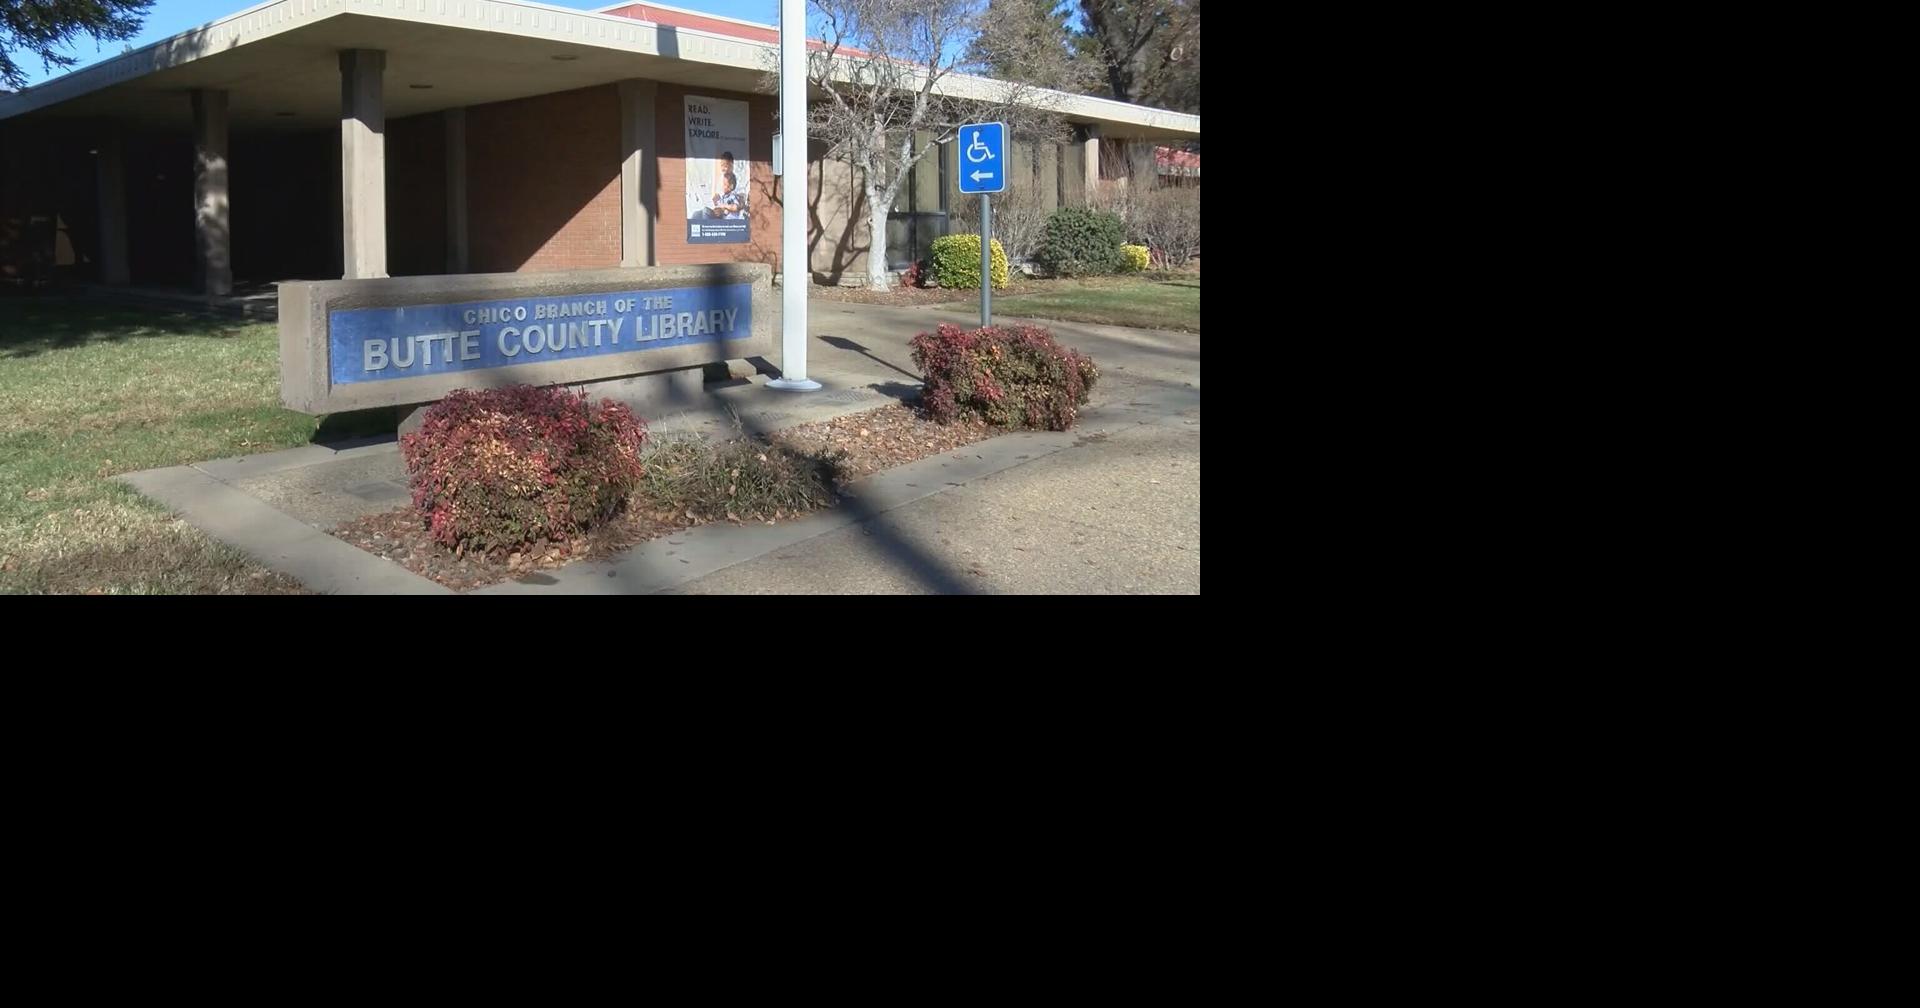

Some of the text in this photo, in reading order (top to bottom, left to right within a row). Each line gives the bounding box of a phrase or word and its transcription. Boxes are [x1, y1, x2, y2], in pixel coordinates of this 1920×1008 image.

[463, 296, 673, 325] CHICO BRANCH OF THE
[363, 308, 738, 371] BUTTE COUNTY LIBRARY
